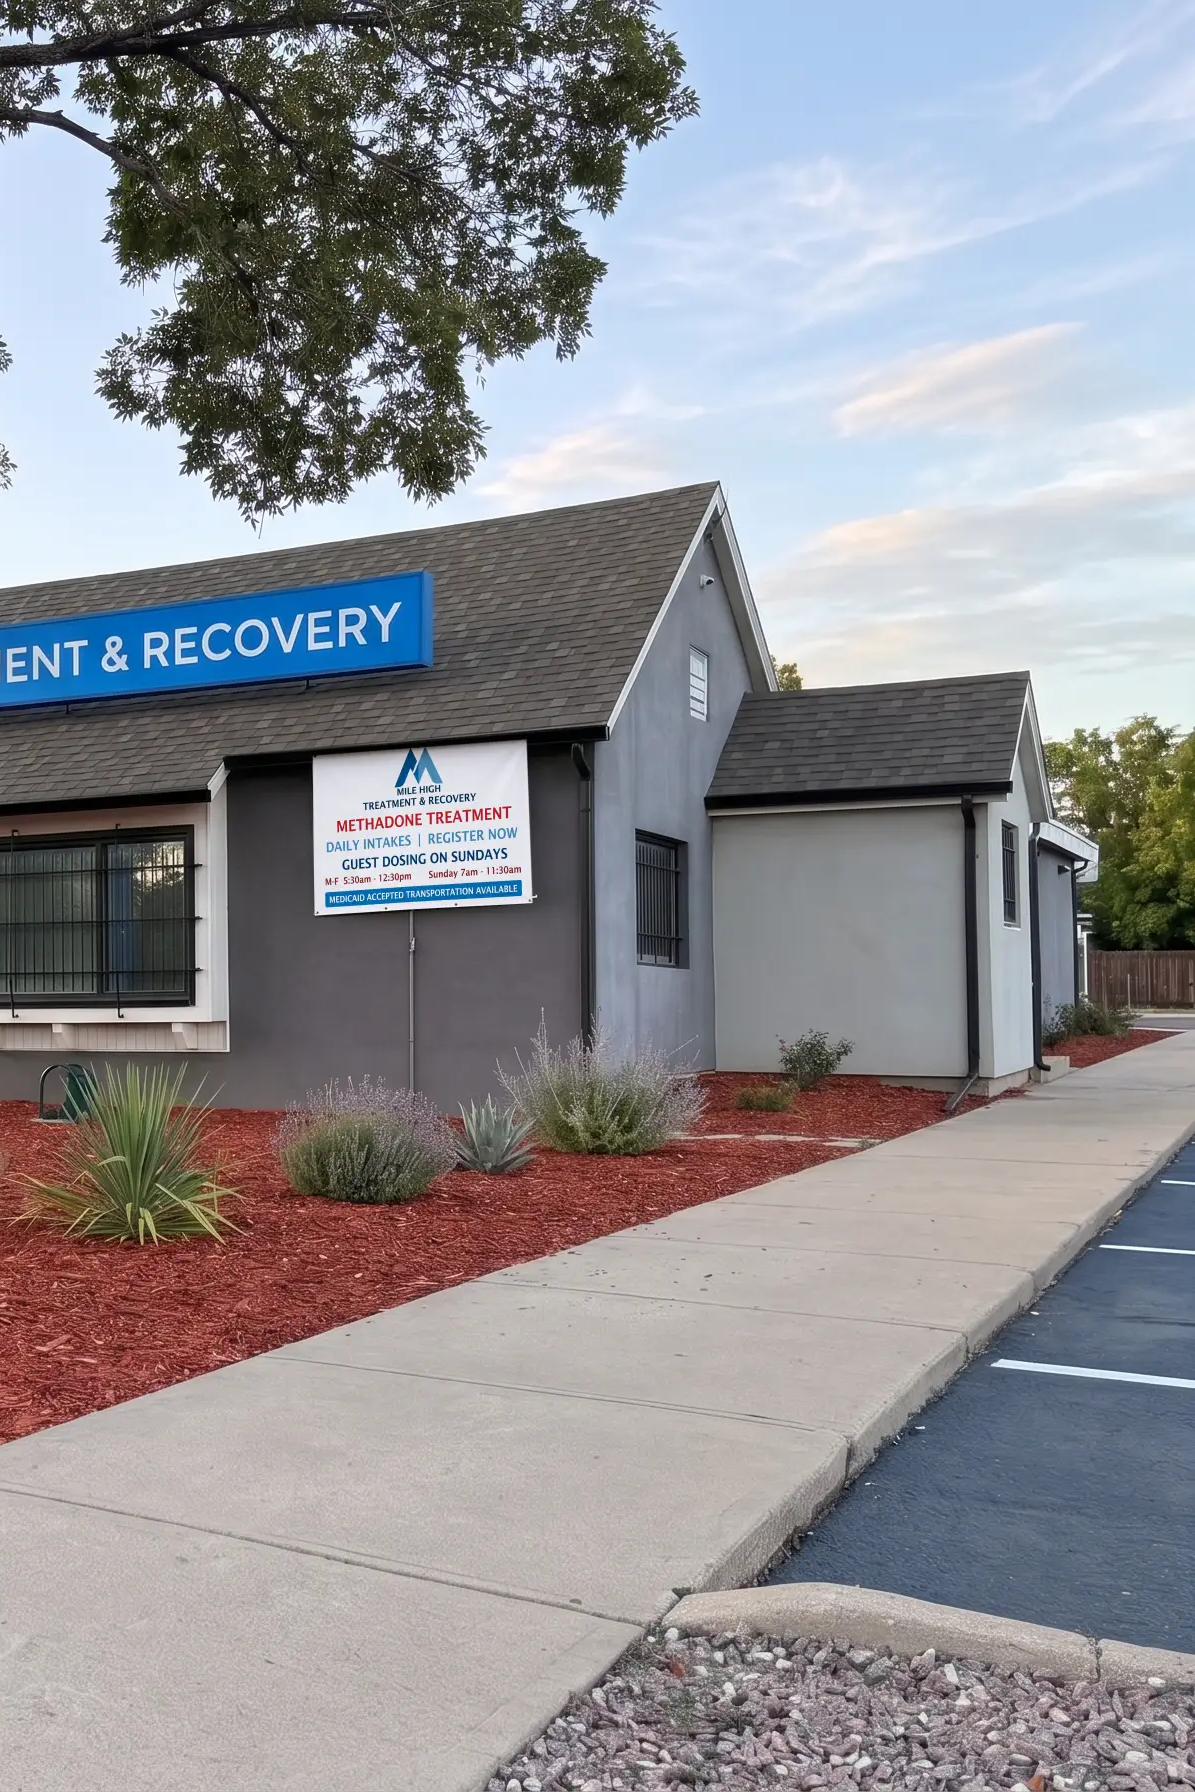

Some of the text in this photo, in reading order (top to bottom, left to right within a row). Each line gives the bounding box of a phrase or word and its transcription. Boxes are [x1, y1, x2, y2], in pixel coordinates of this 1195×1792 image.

[100, 636, 129, 673] &
[143, 601, 403, 669] RECOVERY
[396, 784, 441, 796] MILE HIGH
[363, 792, 477, 811] TREATMENT & RECOVERY
[336, 805, 512, 833] METHADONE TREATMENT
[326, 839, 360, 853] DAILY
[363, 834, 412, 850] INTAKES
[428, 829, 485, 845] REGISTER
[488, 826, 518, 840] NOW
[342, 847, 508, 871] GUEST DOSING ON SUNDAYS
[343, 875, 372, 885] 5:30am
[378, 872, 412, 883] 12:30pm
[428, 868, 458, 879] Sunday
[460, 867, 478, 877] 7am
[486, 865, 522, 876] 11:30am
[329, 884, 518, 904] MEDICAID ACCEPTED TRANSPORTATION AVAILABLE
